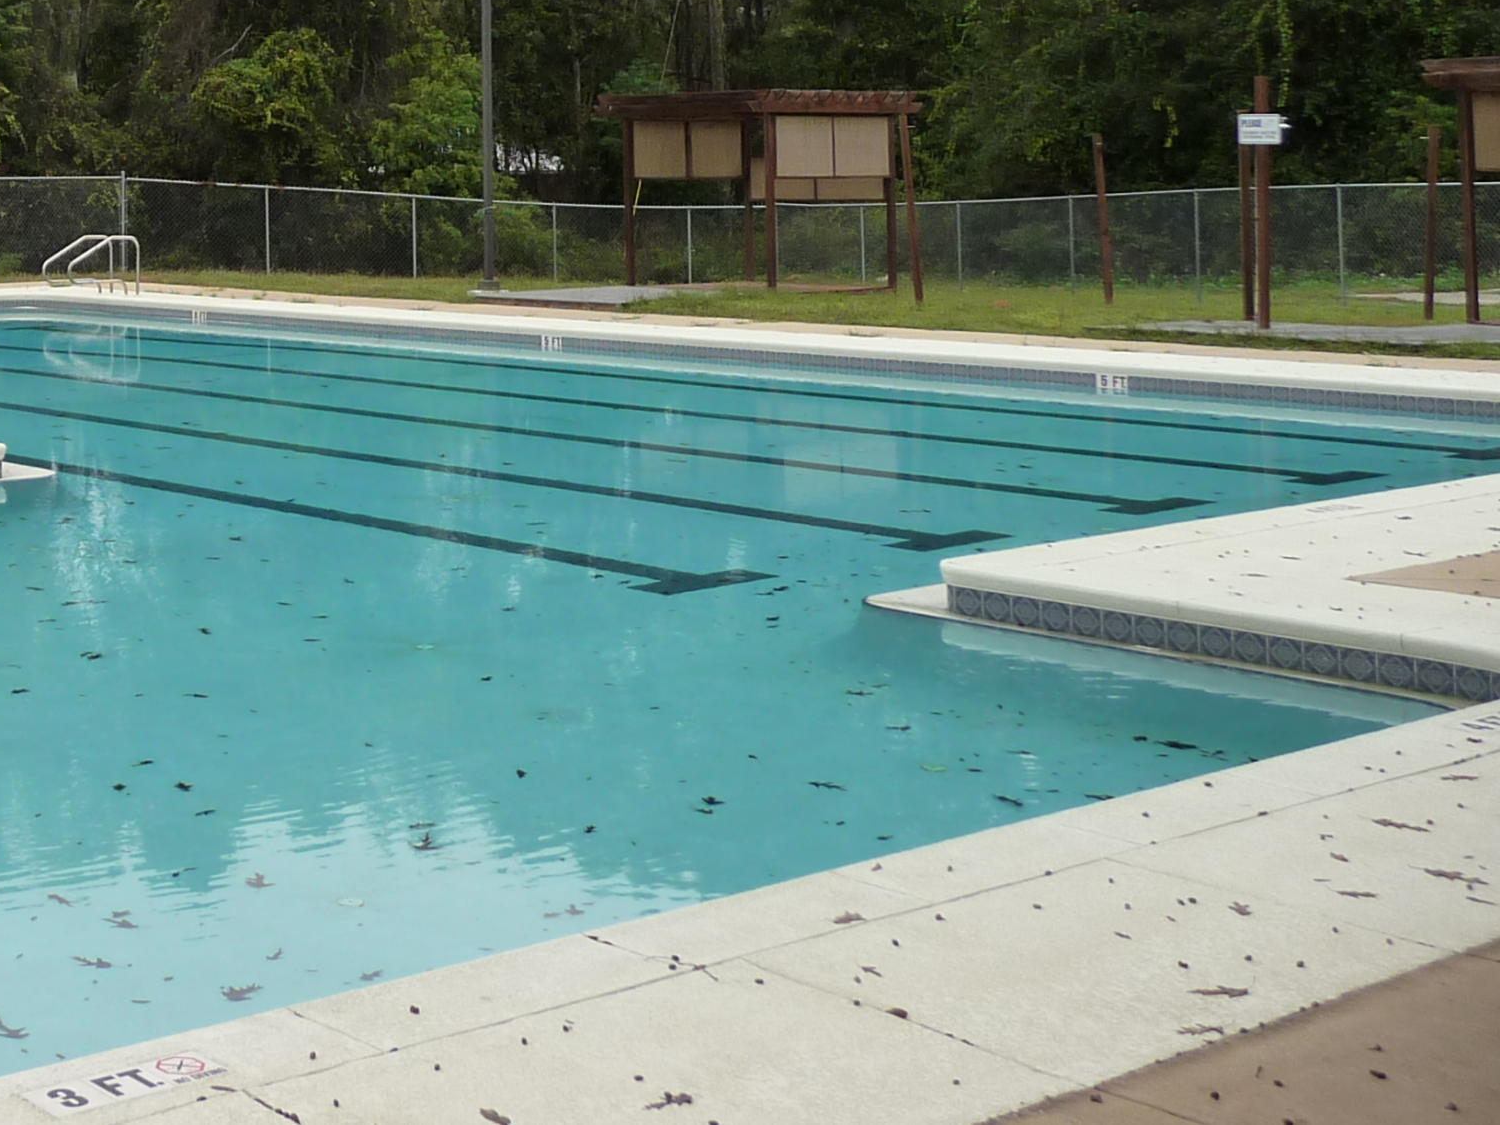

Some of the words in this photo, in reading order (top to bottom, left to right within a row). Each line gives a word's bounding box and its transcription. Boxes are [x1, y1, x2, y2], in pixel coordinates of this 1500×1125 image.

[1100, 374, 1108, 387] 5
[47, 1088, 89, 1108] 3
[90, 1068, 165, 1097] FT.
